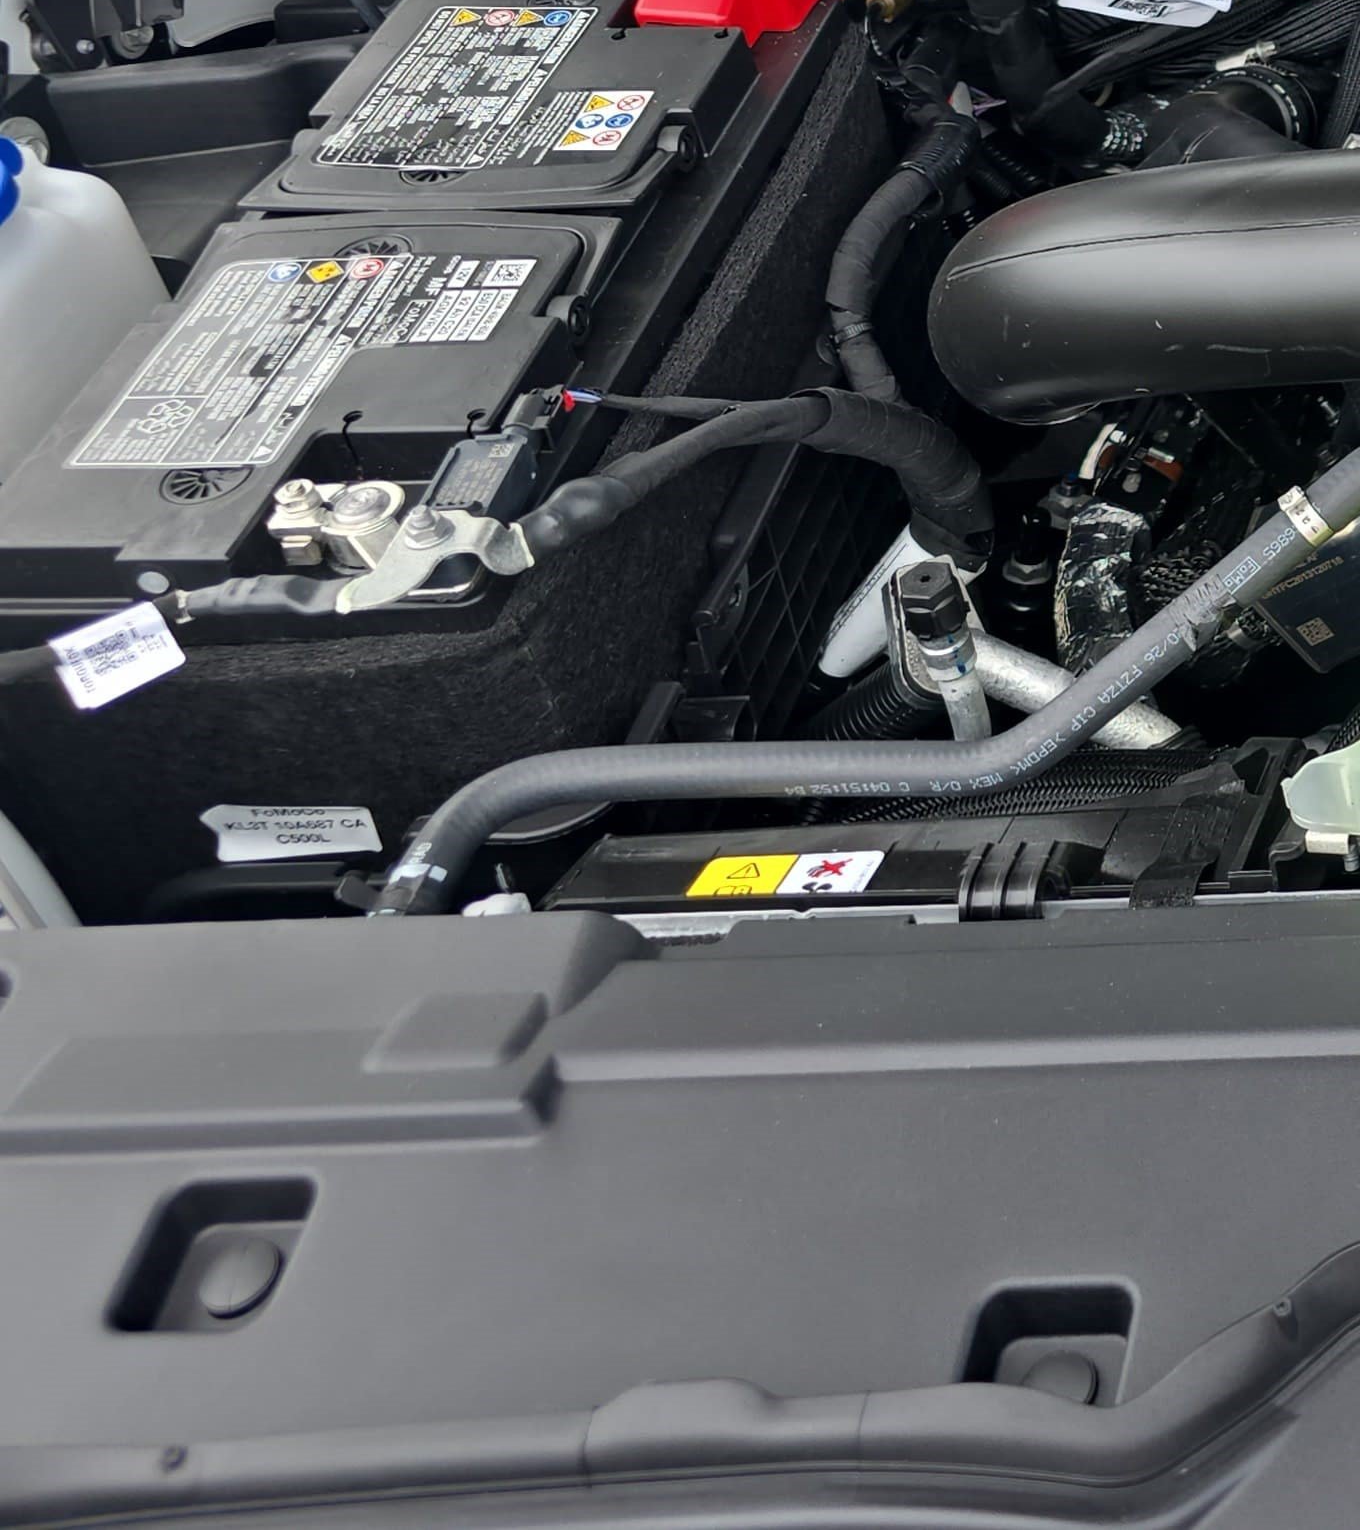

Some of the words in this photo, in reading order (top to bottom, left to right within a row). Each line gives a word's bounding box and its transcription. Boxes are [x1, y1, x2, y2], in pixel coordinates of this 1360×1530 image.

[1071, 705, 1097, 732] CIP
[1010, 732, 1066, 775] >EPDM<
[969, 772, 1004, 790] MEX
